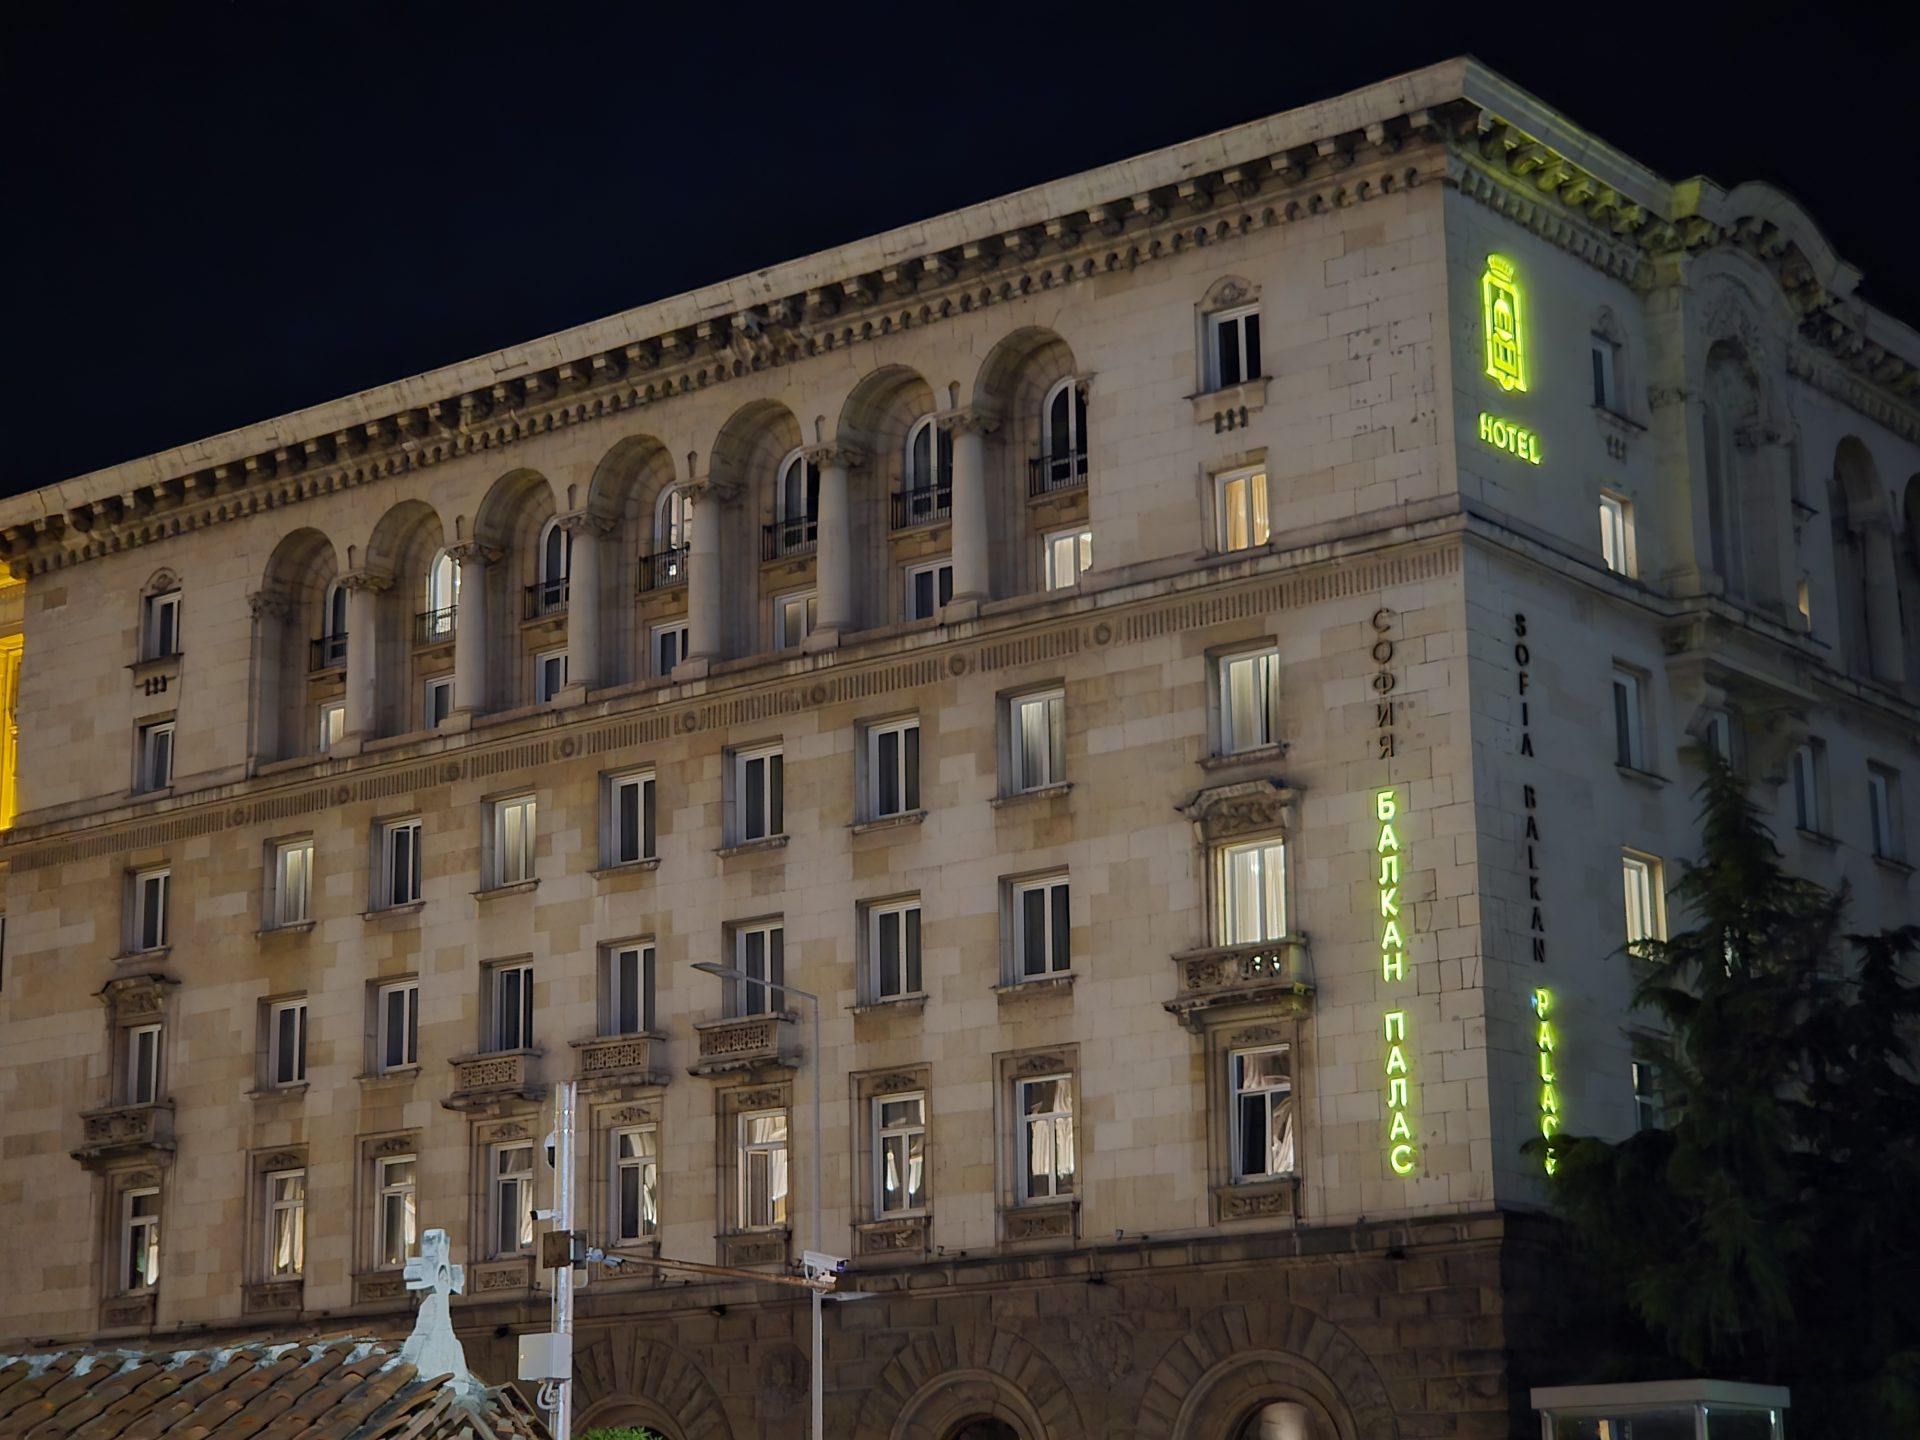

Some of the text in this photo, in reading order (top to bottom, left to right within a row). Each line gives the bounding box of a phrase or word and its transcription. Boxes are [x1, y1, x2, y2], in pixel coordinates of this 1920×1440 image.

[1479, 411, 1541, 465] HOTEL
[1515, 613, 1534, 758] SOFIA
[1372, 607, 1414, 1175] СОФИЯ БАЛКАН ПАЛАС
[1523, 784, 1545, 963] BALKAN
